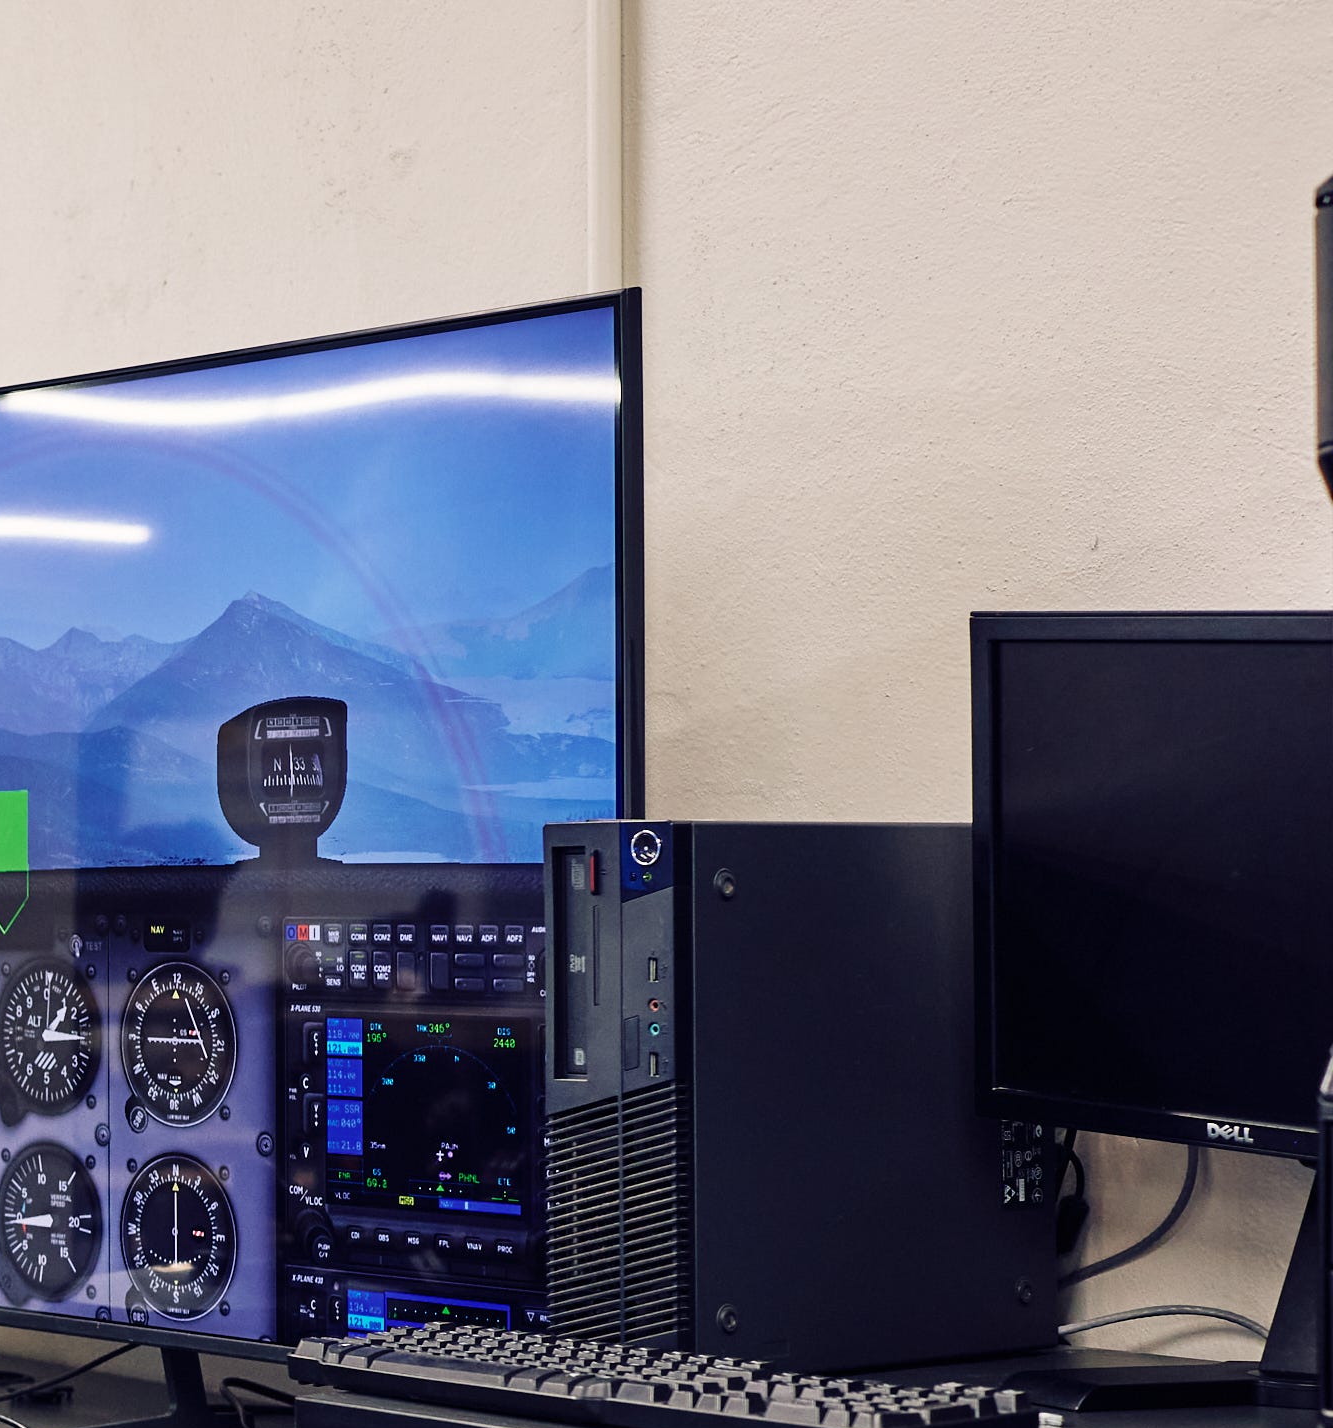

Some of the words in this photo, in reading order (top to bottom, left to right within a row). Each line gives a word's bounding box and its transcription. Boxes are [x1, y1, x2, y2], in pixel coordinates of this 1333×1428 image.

[273, 757, 282, 772] N
[294, 756, 305, 771] 33
[150, 925, 165, 935] NAV
[287, 926, 296, 939] O
[299, 926, 307, 939] M
[350, 933, 367, 941] COM1
[373, 933, 391, 941] COM2
[399, 933, 413, 942] DME
[431, 934, 448, 942] NAV1
[456, 935, 473, 943] NAV2
[480, 935, 497, 943] ADF1
[506, 935, 523, 943] ADF2
[86, 941, 103, 951] TEST
[336, 964, 345, 972] LO
[350, 964, 367, 972] COM1
[373, 965, 391, 973] COM2
[172, 973, 182, 984] 12
[325, 978, 341, 986] SENS
[353, 972, 366, 980] MIC
[376, 973, 389, 981] MIC
[151, 978, 160, 991] E
[194, 982, 204, 995] 15
[292, 983, 307, 991] PILOT
[26, 996, 33, 1009] 9
[135, 1001, 144, 1012] 6
[290, 1004, 311, 1013] X-PLANE
[16, 1005, 23, 1018] 8
[70, 1007, 78, 1020] 2
[210, 1008, 221, 1019] S
[27, 1015, 42, 1028] ALT
[369, 1023, 383, 1031] DTK
[416, 1024, 428, 1033] TRK
[497, 1027, 511, 1036] DIS
[128, 1033, 137, 1041] 3
[313, 1032, 319, 1042] C
[216, 1039, 225, 1052] 21
[493, 1038, 516, 1049] 2440
[17, 1052, 24, 1065] 7
[71, 1055, 79, 1067] 3
[26, 1064, 33, 1076] 6
[60, 1065, 68, 1078] 4
[132, 1063, 142, 1075] N
[43, 1072, 50, 1085] 5
[208, 1069, 220, 1085] 24
[302, 1077, 309, 1089] C
[147, 1088, 159, 1101] 33
[192, 1092, 203, 1107] W
[169, 1099, 180, 1111] 30
[1206, 1122, 1254, 1144] DELL
[341, 1141, 362, 1151] 21.8
[303, 1146, 310, 1159] V
[148, 1169, 160, 1183] 33
[172, 1164, 179, 1176] N
[37, 1173, 47, 1185] 10
[194, 1175, 201, 1186] 3
[458, 1172, 481, 1184] PHNL
[497, 1178, 511, 1187] ETE
[58, 1180, 68, 1192] 15
[21, 1187, 28, 1199] 5
[50, 1193, 72, 1202] VERTICAL
[133, 1192, 143, 1206] 30
[334, 1192, 351, 1200] VLOC
[50, 1200, 66, 1208] SPEED
[210, 1201, 219, 1211] 6
[68, 1216, 80, 1229] 20
[127, 1222, 137, 1236] W
[216, 1233, 226, 1243] E
[350, 1231, 360, 1239] CDI
[378, 1233, 390, 1242] OBS
[407, 1236, 420, 1245] MSG
[438, 1239, 450, 1249] FPL
[466, 1241, 482, 1251] VNAV
[497, 1244, 513, 1254] PROC
[22, 1239, 29, 1251] 5
[60, 1246, 69, 1258] 15
[38, 1254, 47, 1266] 10
[132, 1253, 144, 1267] 24
[209, 1263, 220, 1277] 12
[292, 1274, 314, 1284] X-PLANE
[149, 1280, 160, 1293] 21
[193, 1284, 203, 1298] 15
[173, 1291, 180, 1304] S
[310, 1299, 317, 1311] C
[132, 1312, 145, 1323] OBS
